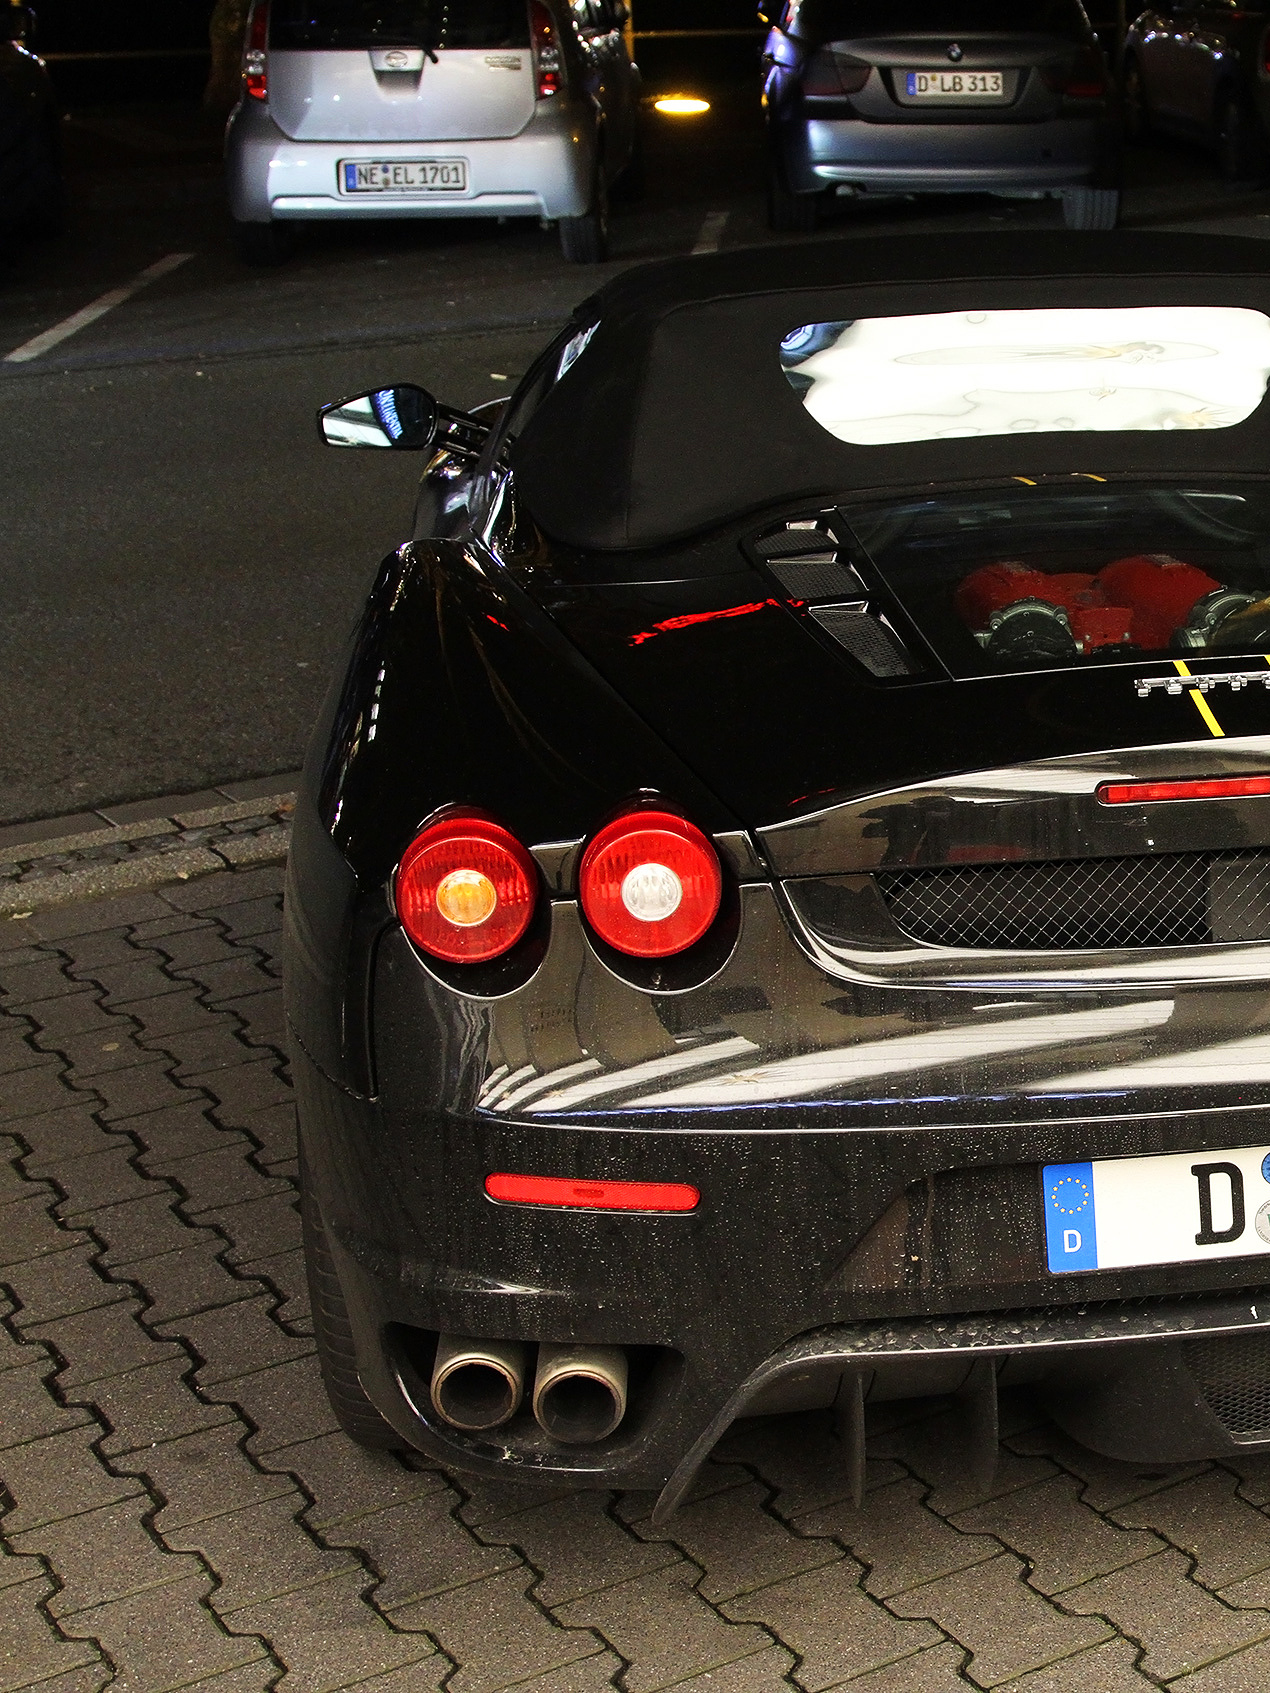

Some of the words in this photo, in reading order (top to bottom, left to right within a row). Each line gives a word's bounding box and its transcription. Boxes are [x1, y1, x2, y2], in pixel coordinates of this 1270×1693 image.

[917, 75, 928, 92] D
[941, 75, 963, 92] LB
[968, 75, 1000, 92] 313
[358, 167, 379, 185] NE
[393, 167, 415, 184] EL
[420, 166, 460, 184] 1701
[1191, 1162, 1245, 1245] D
[1063, 1229, 1082, 1253] D
